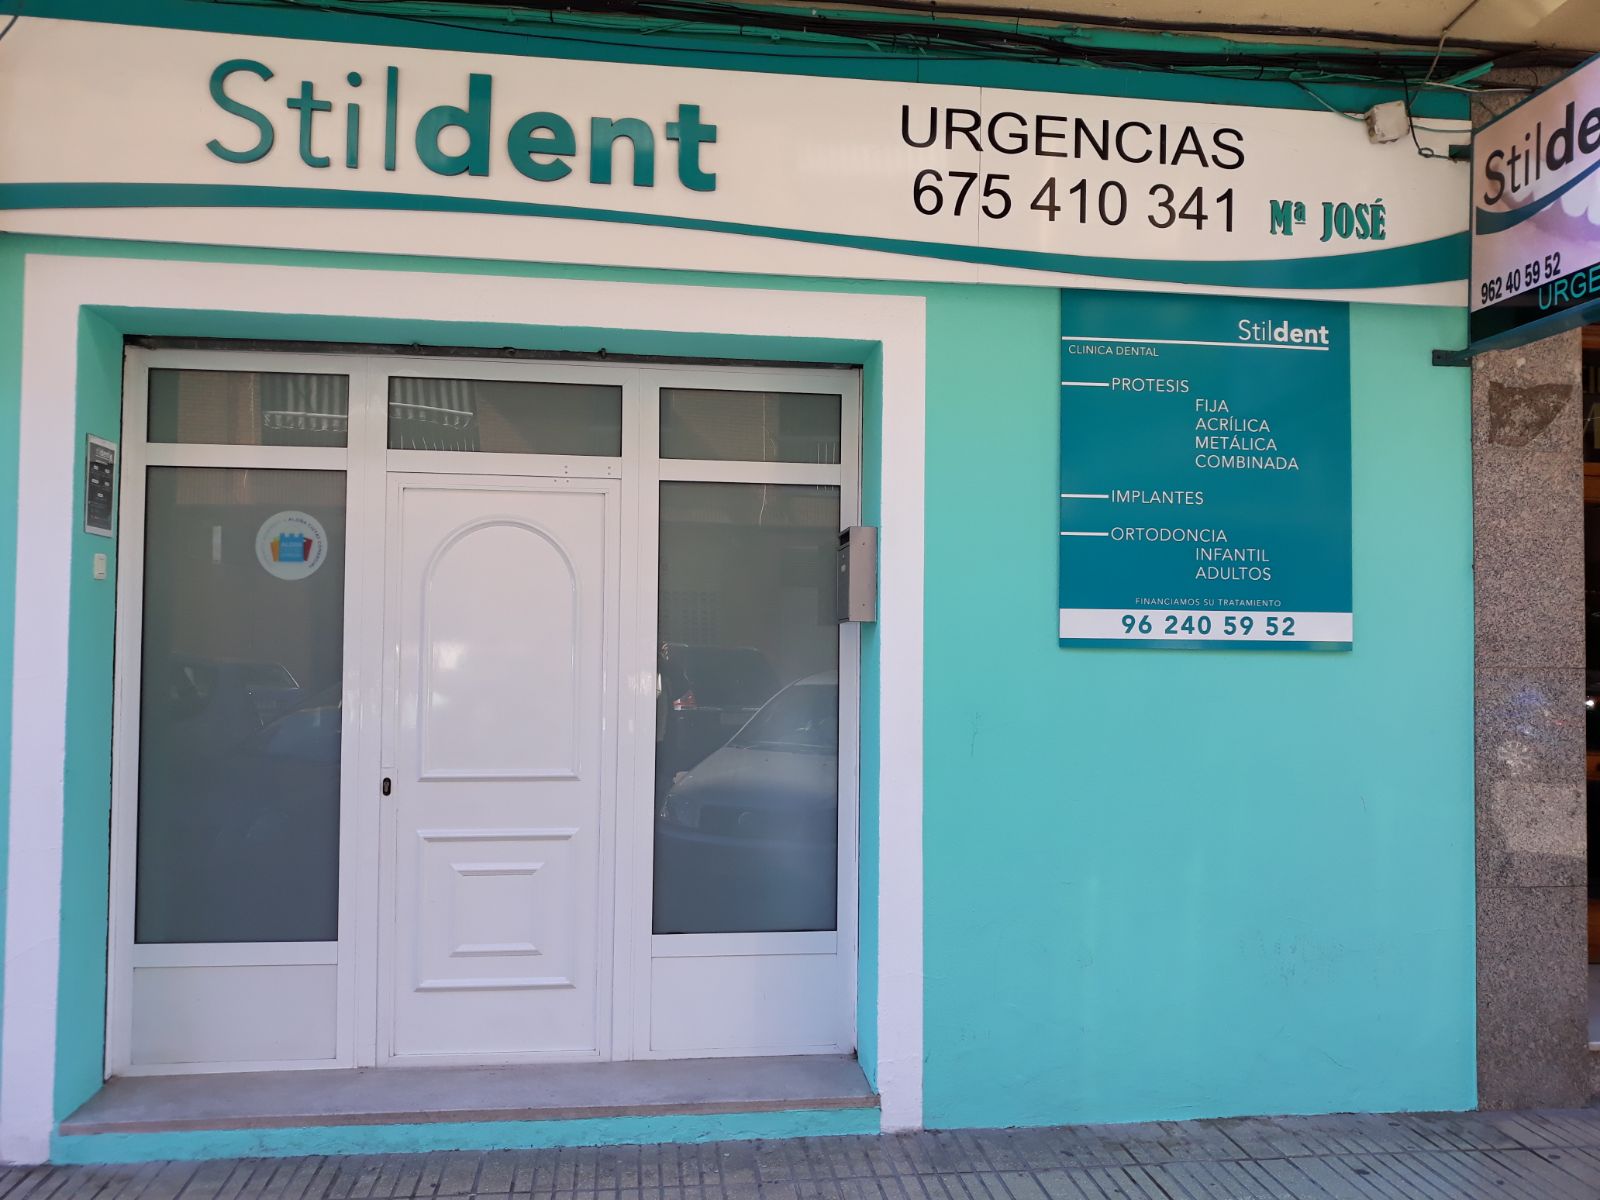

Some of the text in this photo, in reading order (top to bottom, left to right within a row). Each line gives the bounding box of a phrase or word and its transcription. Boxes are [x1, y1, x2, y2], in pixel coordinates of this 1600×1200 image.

[206, 58, 717, 192] Stildent
[902, 104, 1245, 169] URGENCIAS
[913, 169, 1233, 232] 675 410 341
[1269, 197, 1386, 242] Mª JOSÉ
[1481, 251, 1561, 305] 962 40 59 52
[1538, 264, 1600, 310] URGE
[1238, 319, 1330, 345] Stildent
[1068, 344, 1159, 357] CLINICA DENTAL
[1111, 377, 1189, 393] PROTESIS
[1195, 398, 1229, 413] FIJA
[1195, 416, 1271, 433] ACRÍLICA
[1195, 434, 1278, 451] METÁLICA
[1195, 454, 1299, 470] COMBINADA
[1111, 489, 1204, 505] IMPLANTES
[1110, 527, 1228, 543] ORTODONCIA
[1196, 547, 1270, 562] INFANTIL
[1195, 566, 1271, 581] ADULTOS
[1135, 597, 1281, 608] FINANCIAMOS SU TRATAMIENTO
[1121, 614, 1295, 637] 96 240 59 52
